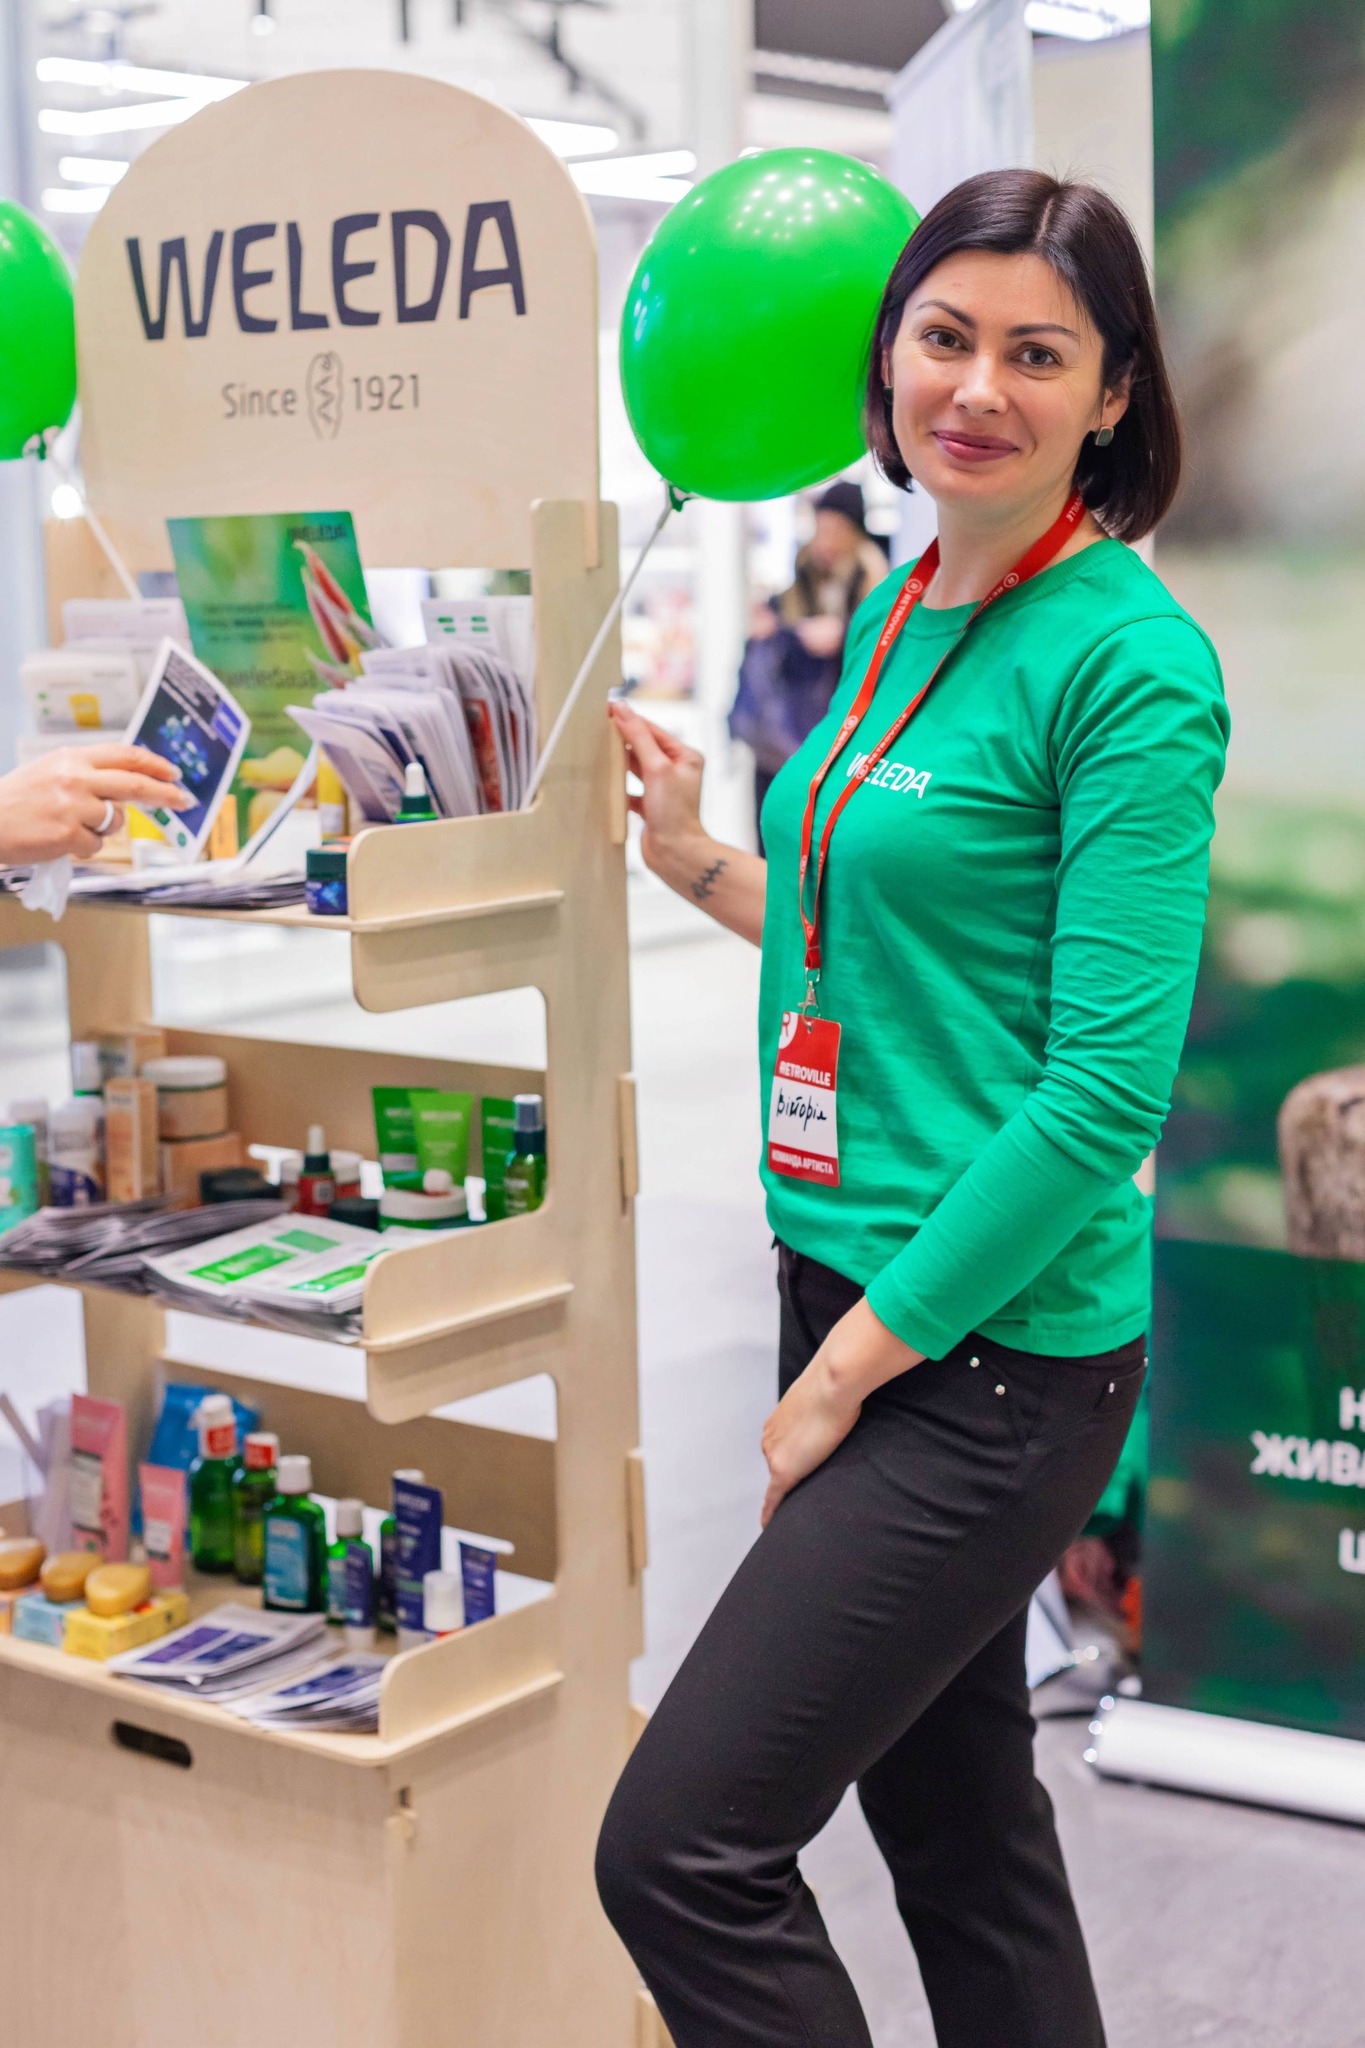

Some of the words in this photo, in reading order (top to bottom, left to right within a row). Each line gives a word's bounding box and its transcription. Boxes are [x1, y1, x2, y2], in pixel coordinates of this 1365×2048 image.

[126, 199, 527, 340] WELEDA
[221, 382, 297, 419] Since
[352, 373, 419, 412] 1921
[778, 1061, 831, 1087] RETROVILLE
